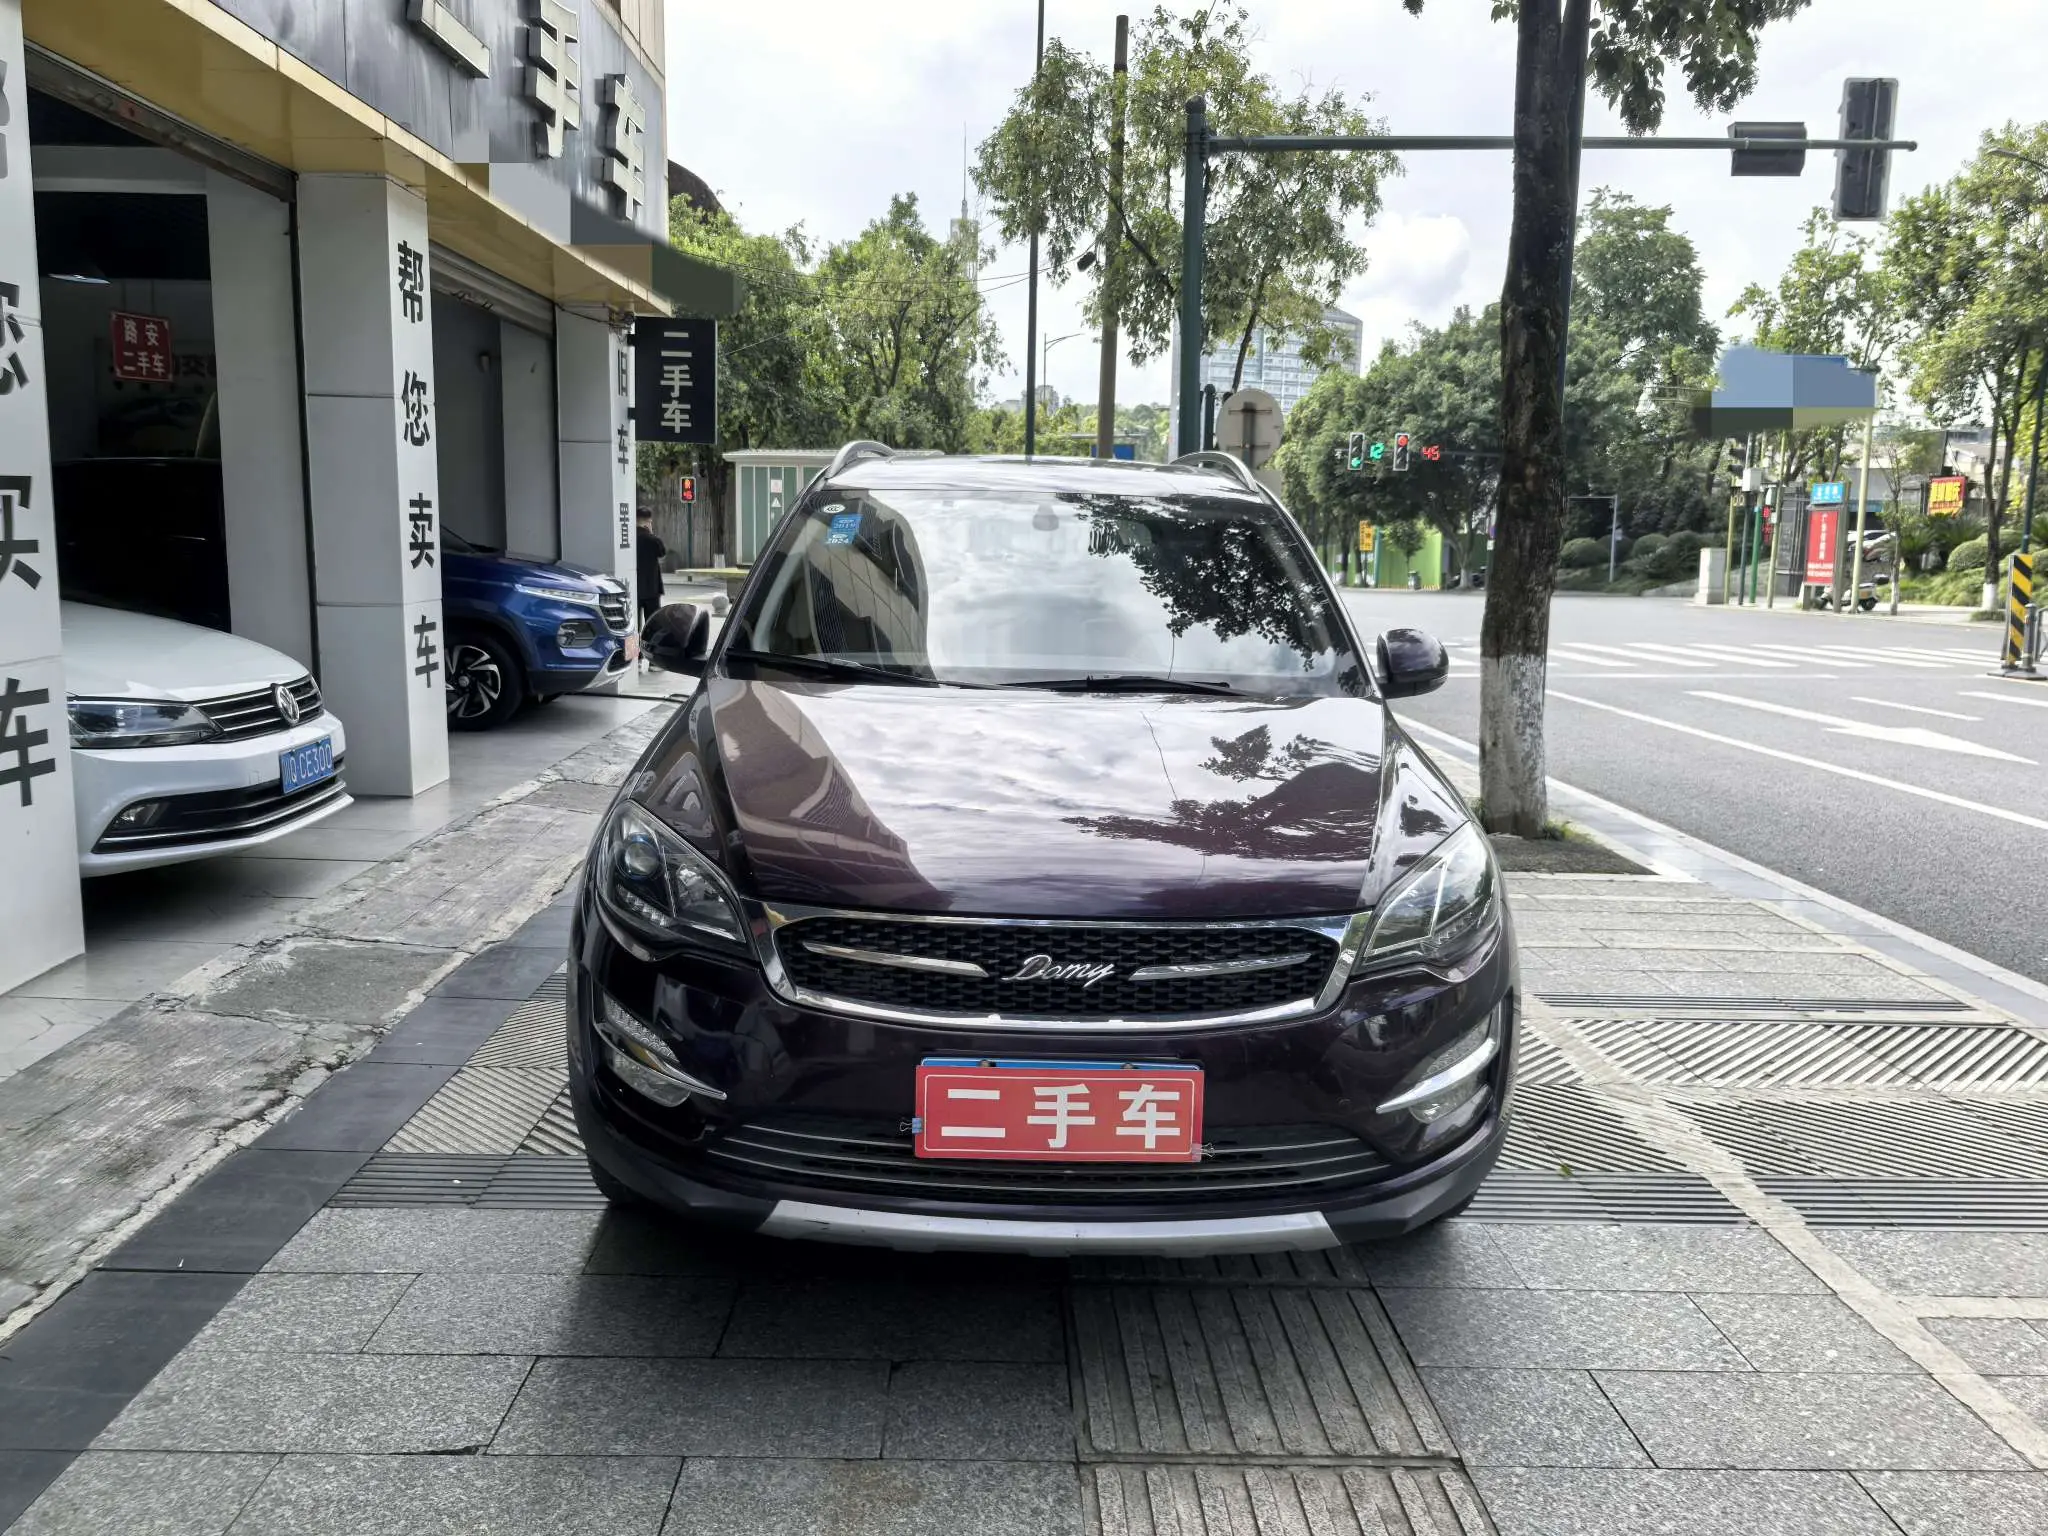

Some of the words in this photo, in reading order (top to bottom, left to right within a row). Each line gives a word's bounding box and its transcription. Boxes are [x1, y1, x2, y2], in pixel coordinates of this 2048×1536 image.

[123, 351, 165, 376] 二手车
[660, 331, 694, 434] 二手车
[397, 241, 440, 689] 帮您卖车
[1001, 954, 1116, 988] Domy
[940, 1083, 1181, 1149] 二手车
